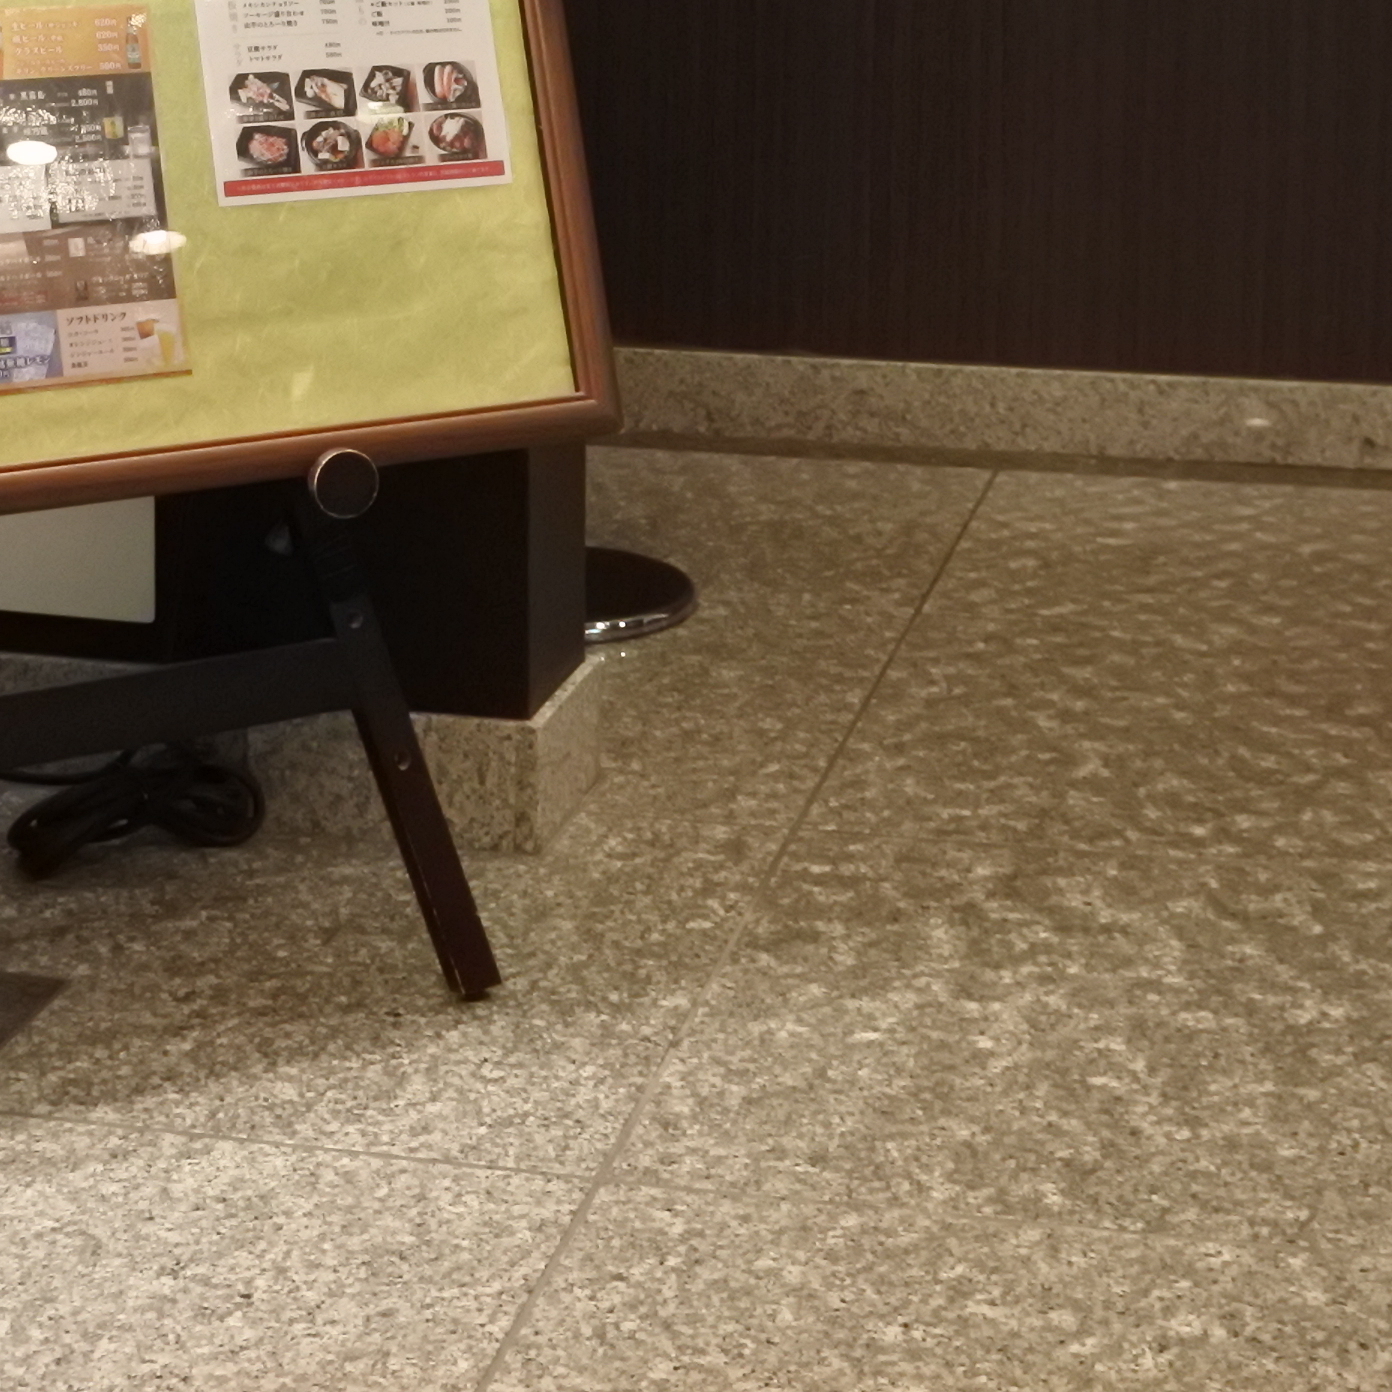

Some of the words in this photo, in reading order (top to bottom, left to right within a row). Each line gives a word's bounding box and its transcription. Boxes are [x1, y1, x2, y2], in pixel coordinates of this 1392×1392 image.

[15, 45, 63, 56] グラスビール
[66, 311, 127, 326] ソフトドリンク
